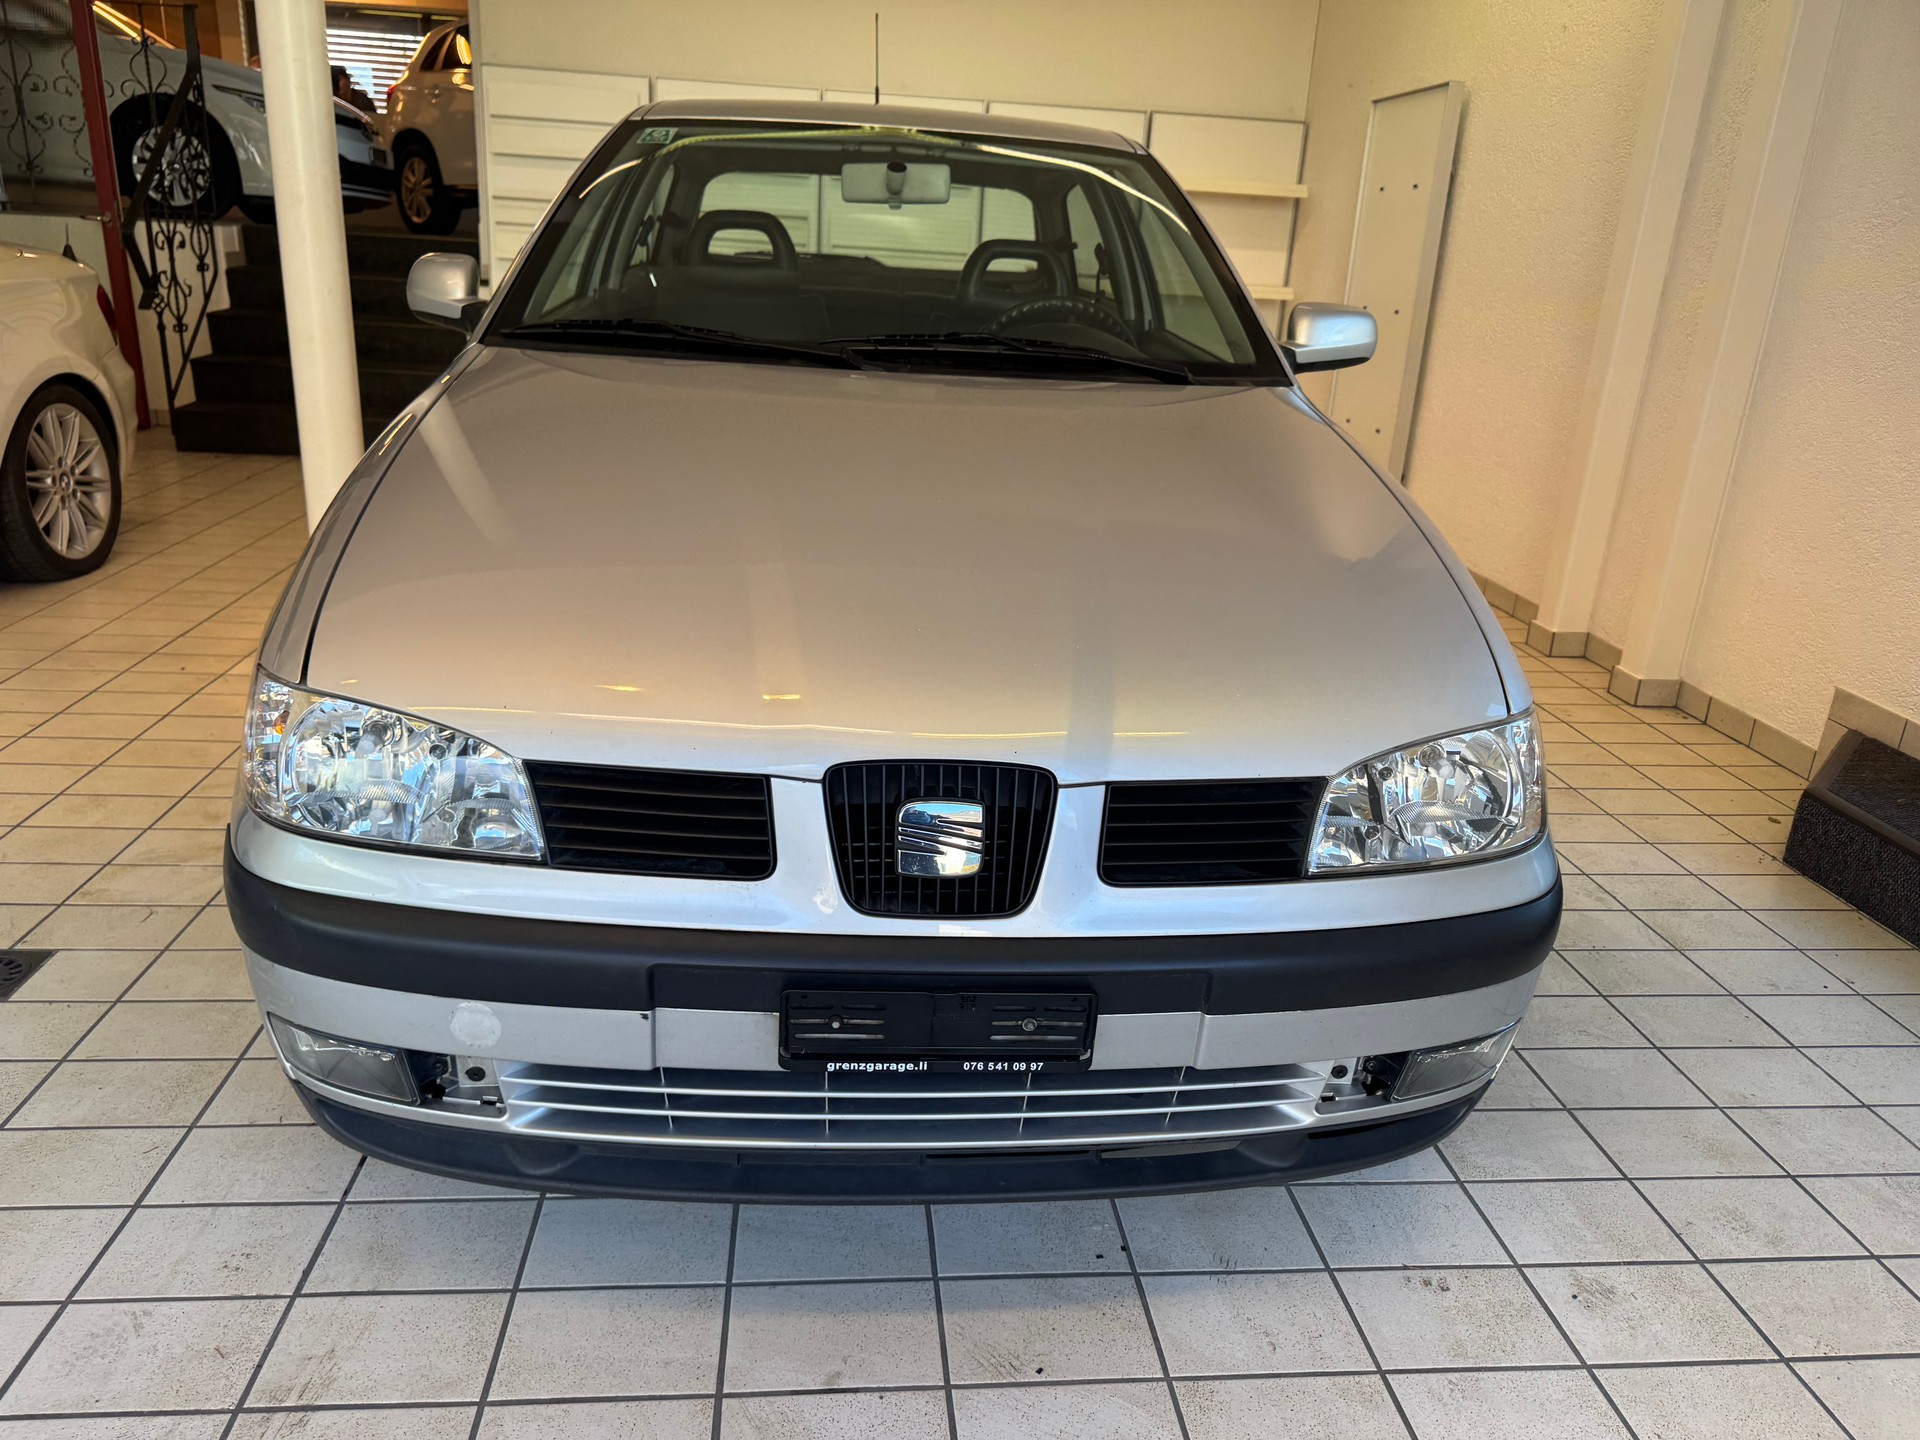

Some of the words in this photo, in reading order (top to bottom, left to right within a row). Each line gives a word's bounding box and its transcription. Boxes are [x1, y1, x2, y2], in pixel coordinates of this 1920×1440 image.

[826, 1061, 928, 1072] grenzgarage.li
[963, 1061, 984, 1071] 076
[987, 1061, 1009, 1071] 541
[1012, 1061, 1027, 1071] 09
[1029, 1062, 1044, 1071] 97
